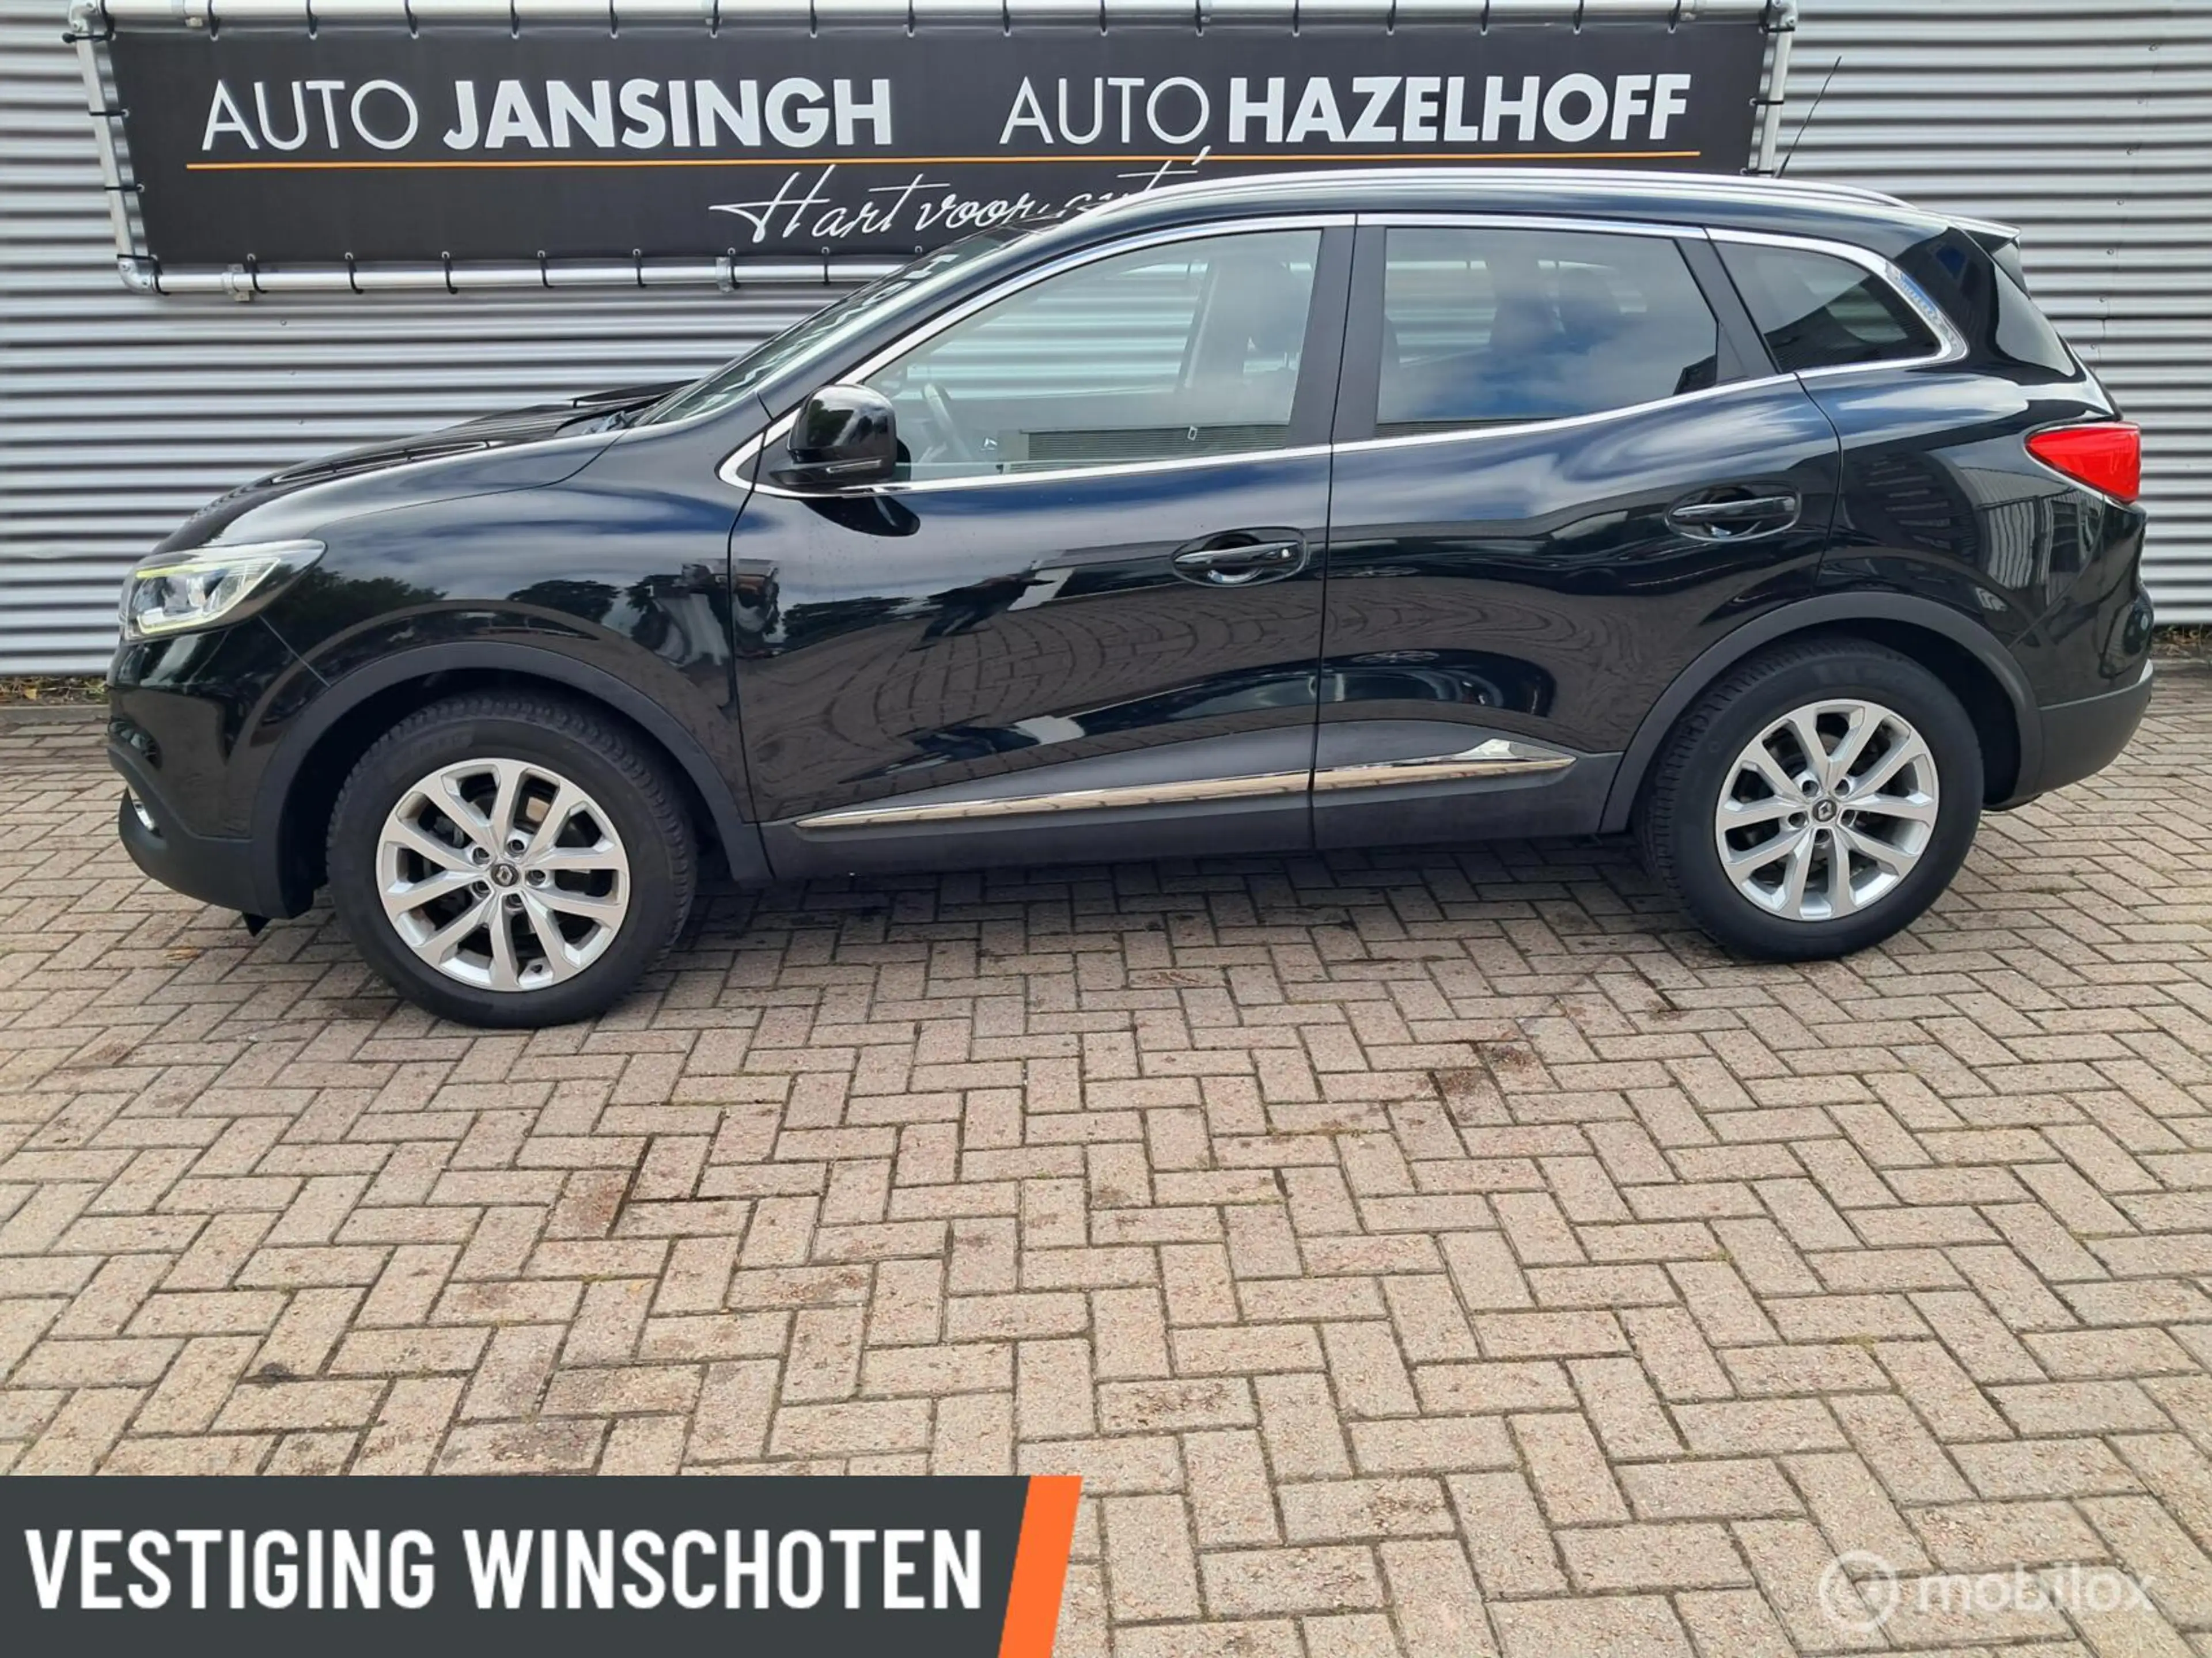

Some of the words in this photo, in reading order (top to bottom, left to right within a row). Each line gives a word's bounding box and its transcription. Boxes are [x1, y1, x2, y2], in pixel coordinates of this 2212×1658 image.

[202, 79, 419, 150] AUTO
[443, 77, 892, 150] JANSINGH
[999, 76, 1210, 145] AUTO
[1228, 73, 1691, 143] HAZELHOFF
[709, 164, 950, 243] Hart
